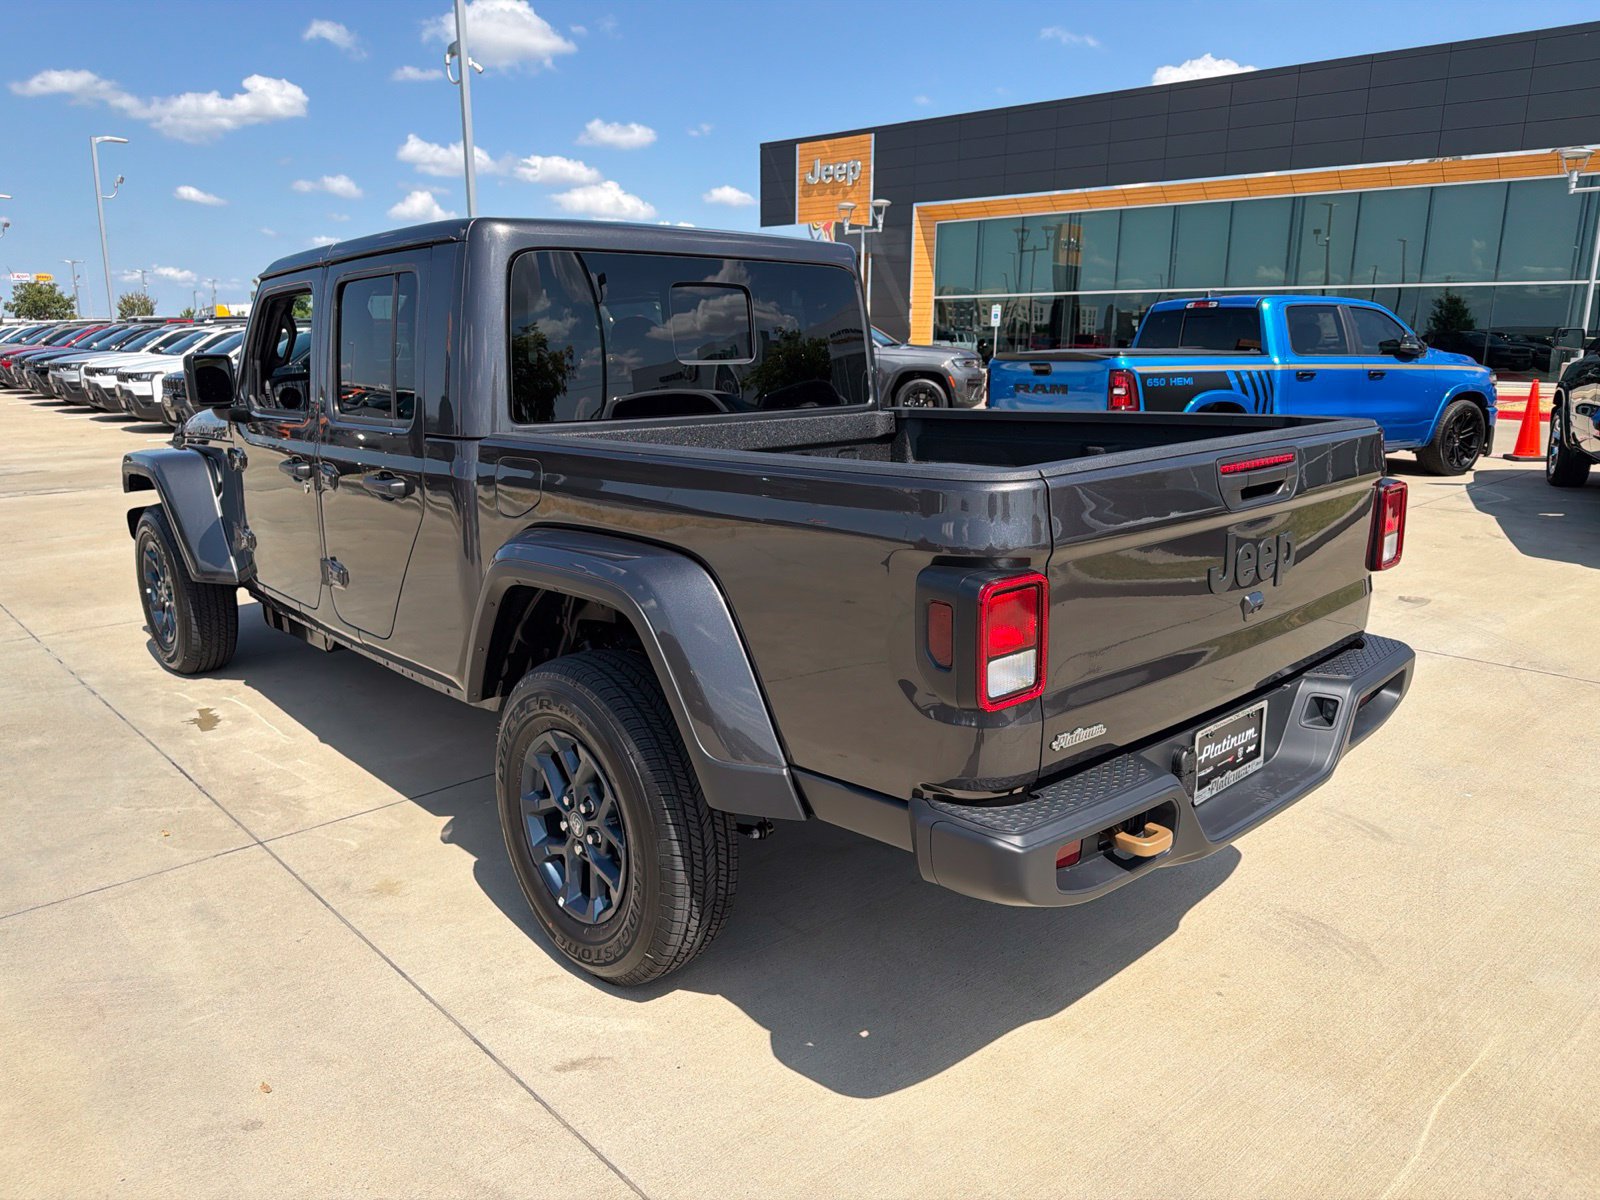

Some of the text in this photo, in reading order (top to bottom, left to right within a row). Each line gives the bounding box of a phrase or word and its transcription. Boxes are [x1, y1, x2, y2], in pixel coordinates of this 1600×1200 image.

[805, 158, 862, 186] Jeep
[1014, 383, 1069, 395] RAM
[1146, 376, 1194, 387] 650 HEMI
[1207, 531, 1296, 594] Jeep
[1051, 723, 1107, 751] Platinum
[1197, 727, 1258, 763] Platinum
[554, 853, 641, 963] BRIDGESTONE
